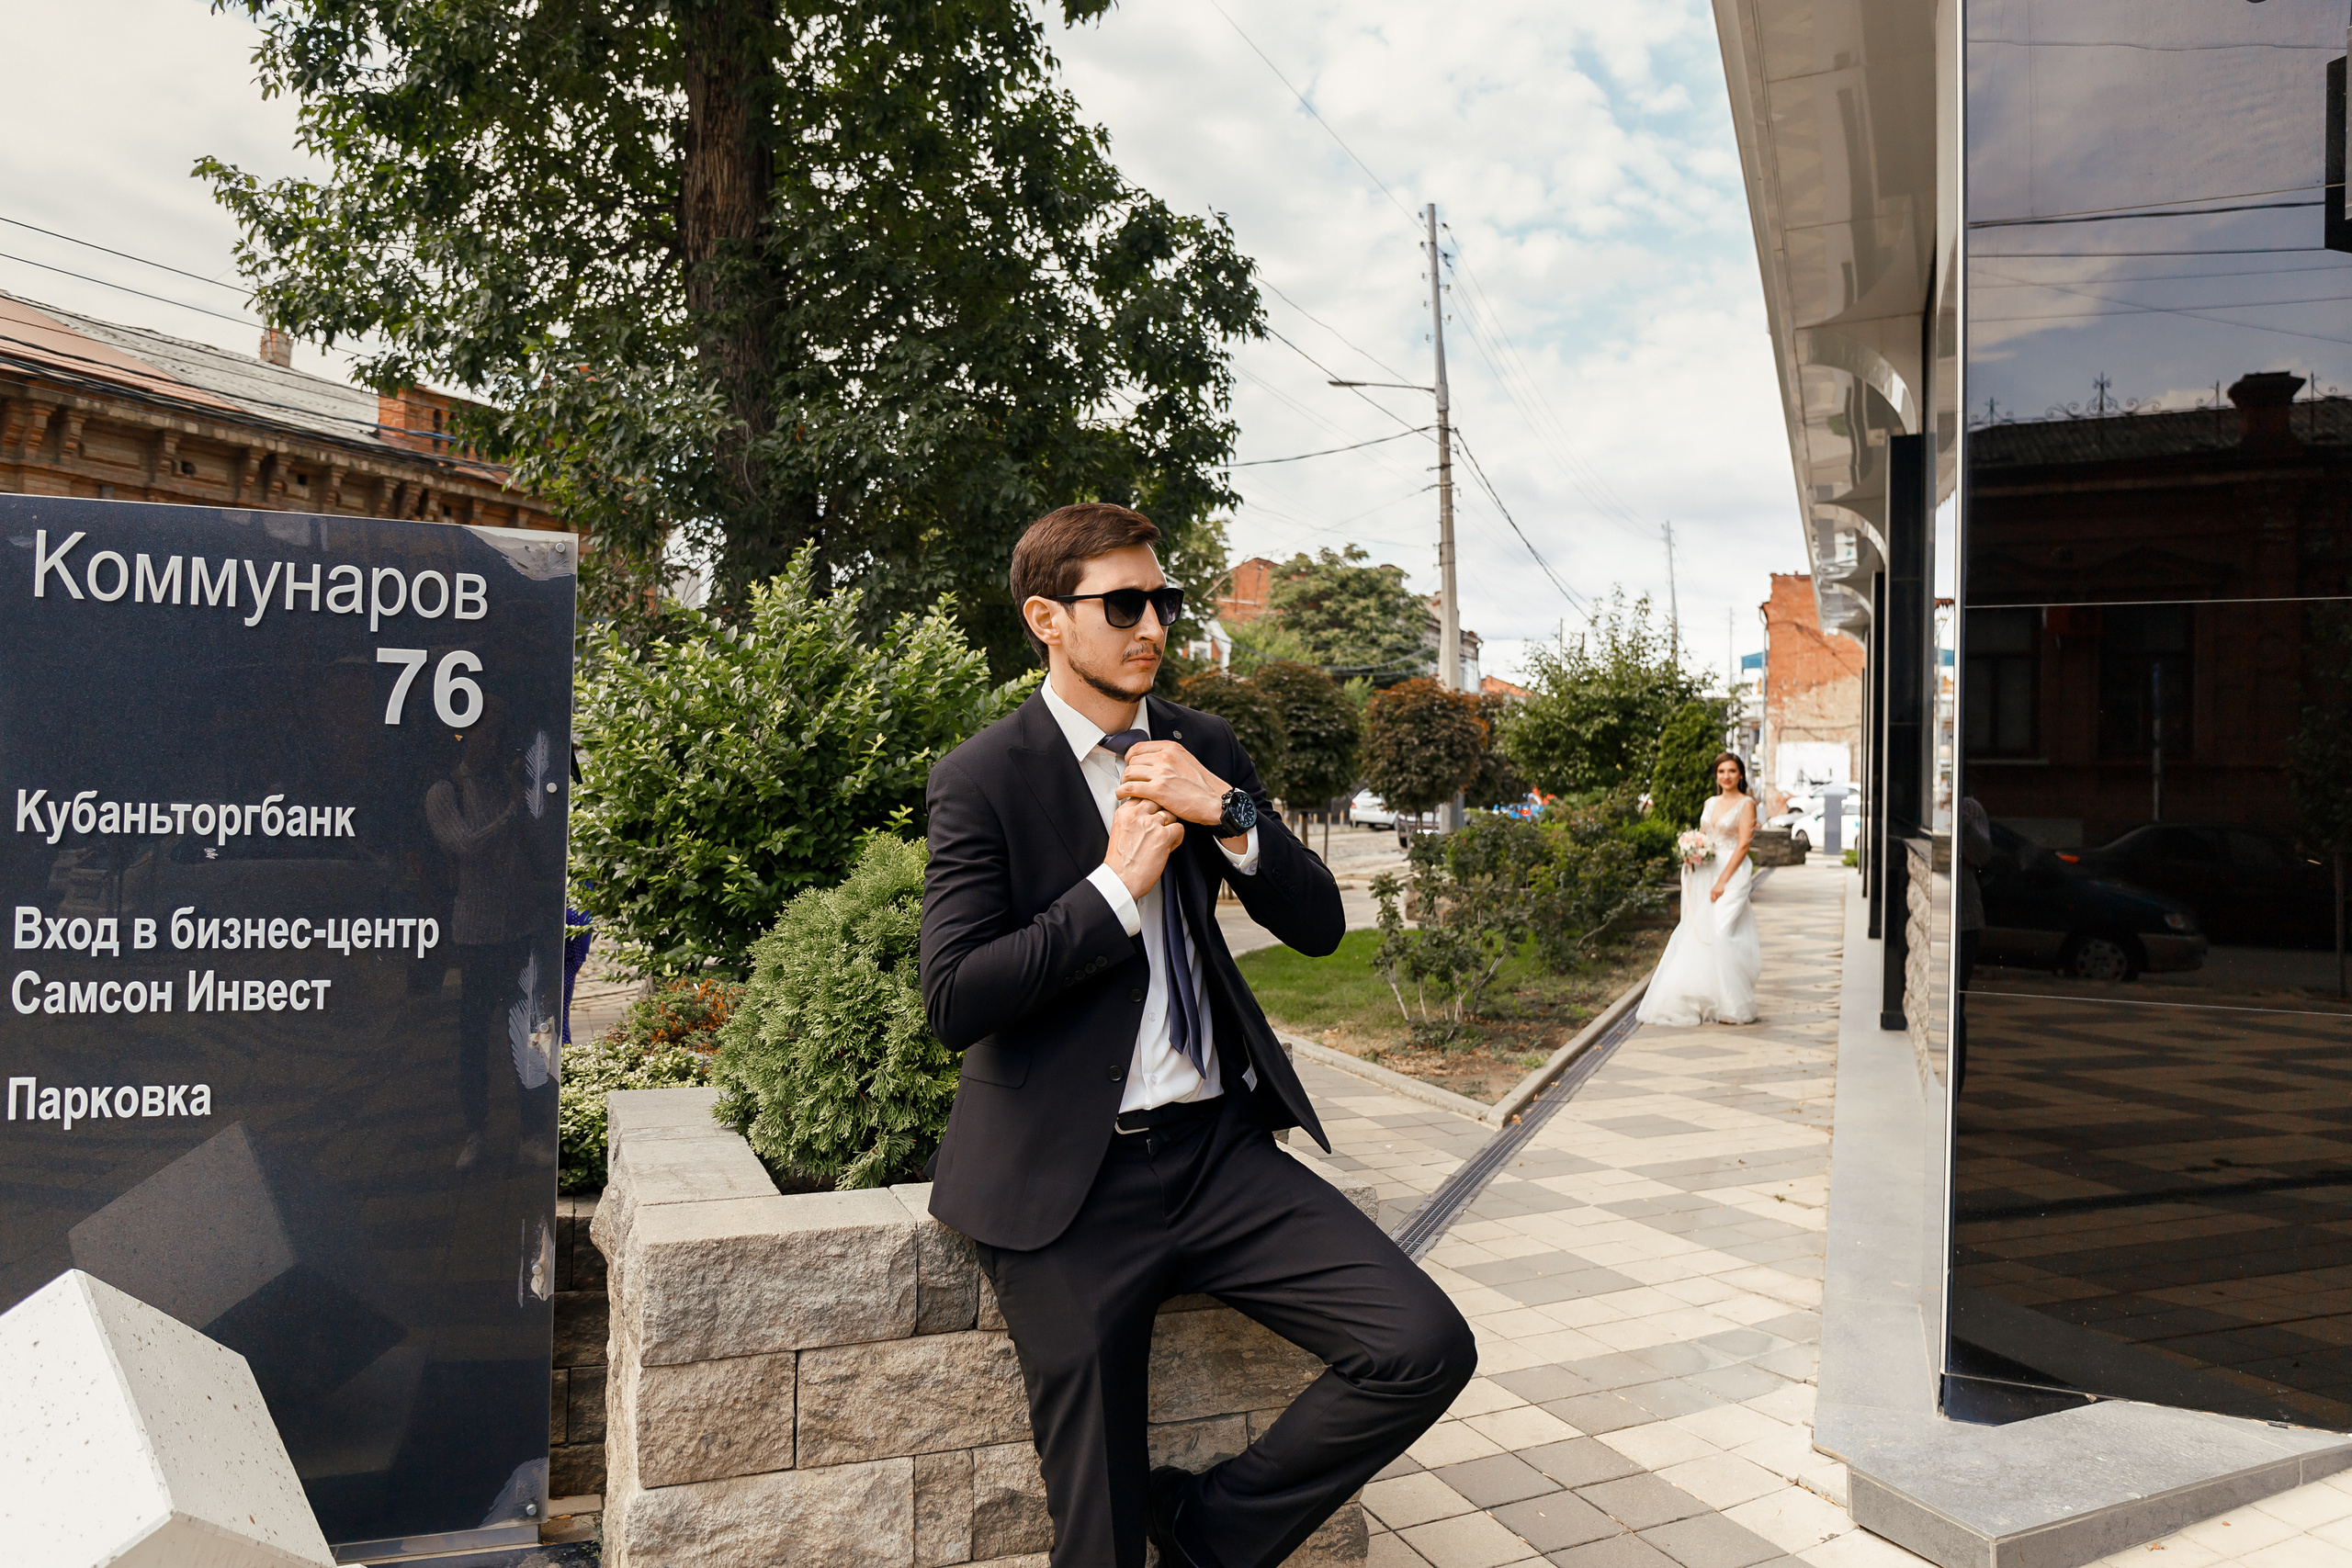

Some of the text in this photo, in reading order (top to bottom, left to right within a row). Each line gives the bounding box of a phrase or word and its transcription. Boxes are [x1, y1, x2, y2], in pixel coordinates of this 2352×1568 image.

[34, 529, 489, 632] Коммунаров
[377, 648, 483, 728] 76
[16, 788, 356, 845] Кубаньторгбанк
[14, 906, 439, 958] Вход в бизнес-центр
[12, 969, 332, 1015] Самсон Инвест
[7, 1077, 211, 1130] Парковка
